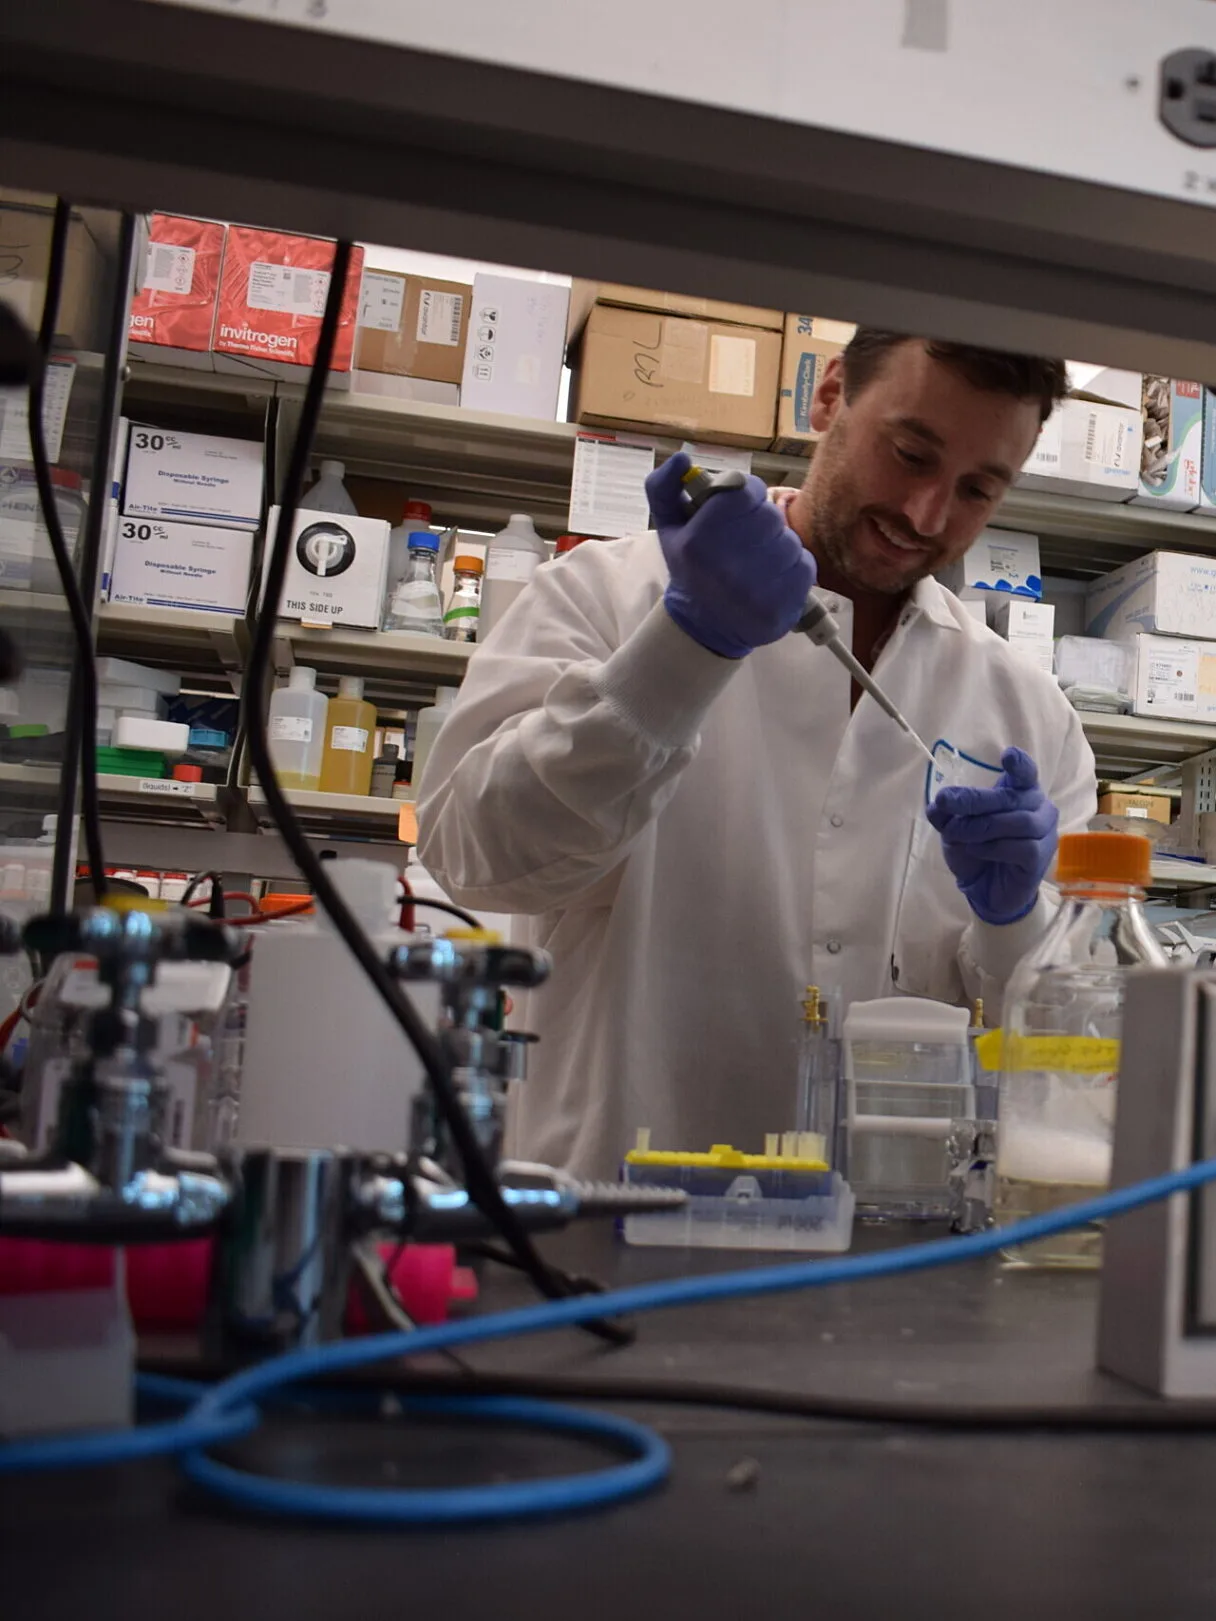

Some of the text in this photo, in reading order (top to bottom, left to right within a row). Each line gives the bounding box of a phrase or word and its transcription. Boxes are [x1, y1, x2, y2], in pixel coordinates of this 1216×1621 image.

[220, 323, 297, 349] invitrogen
[135, 432, 165, 452] 30
[158, 470, 230, 485] Disposable Syringe
[129, 503, 158, 512] Air-Tite
[121, 522, 151, 541] 30
[144, 560, 217, 575] Disposable Syringe
[114, 593, 144, 603] Air-Tite
[286, 600, 343, 615] THIS SIDE UP
